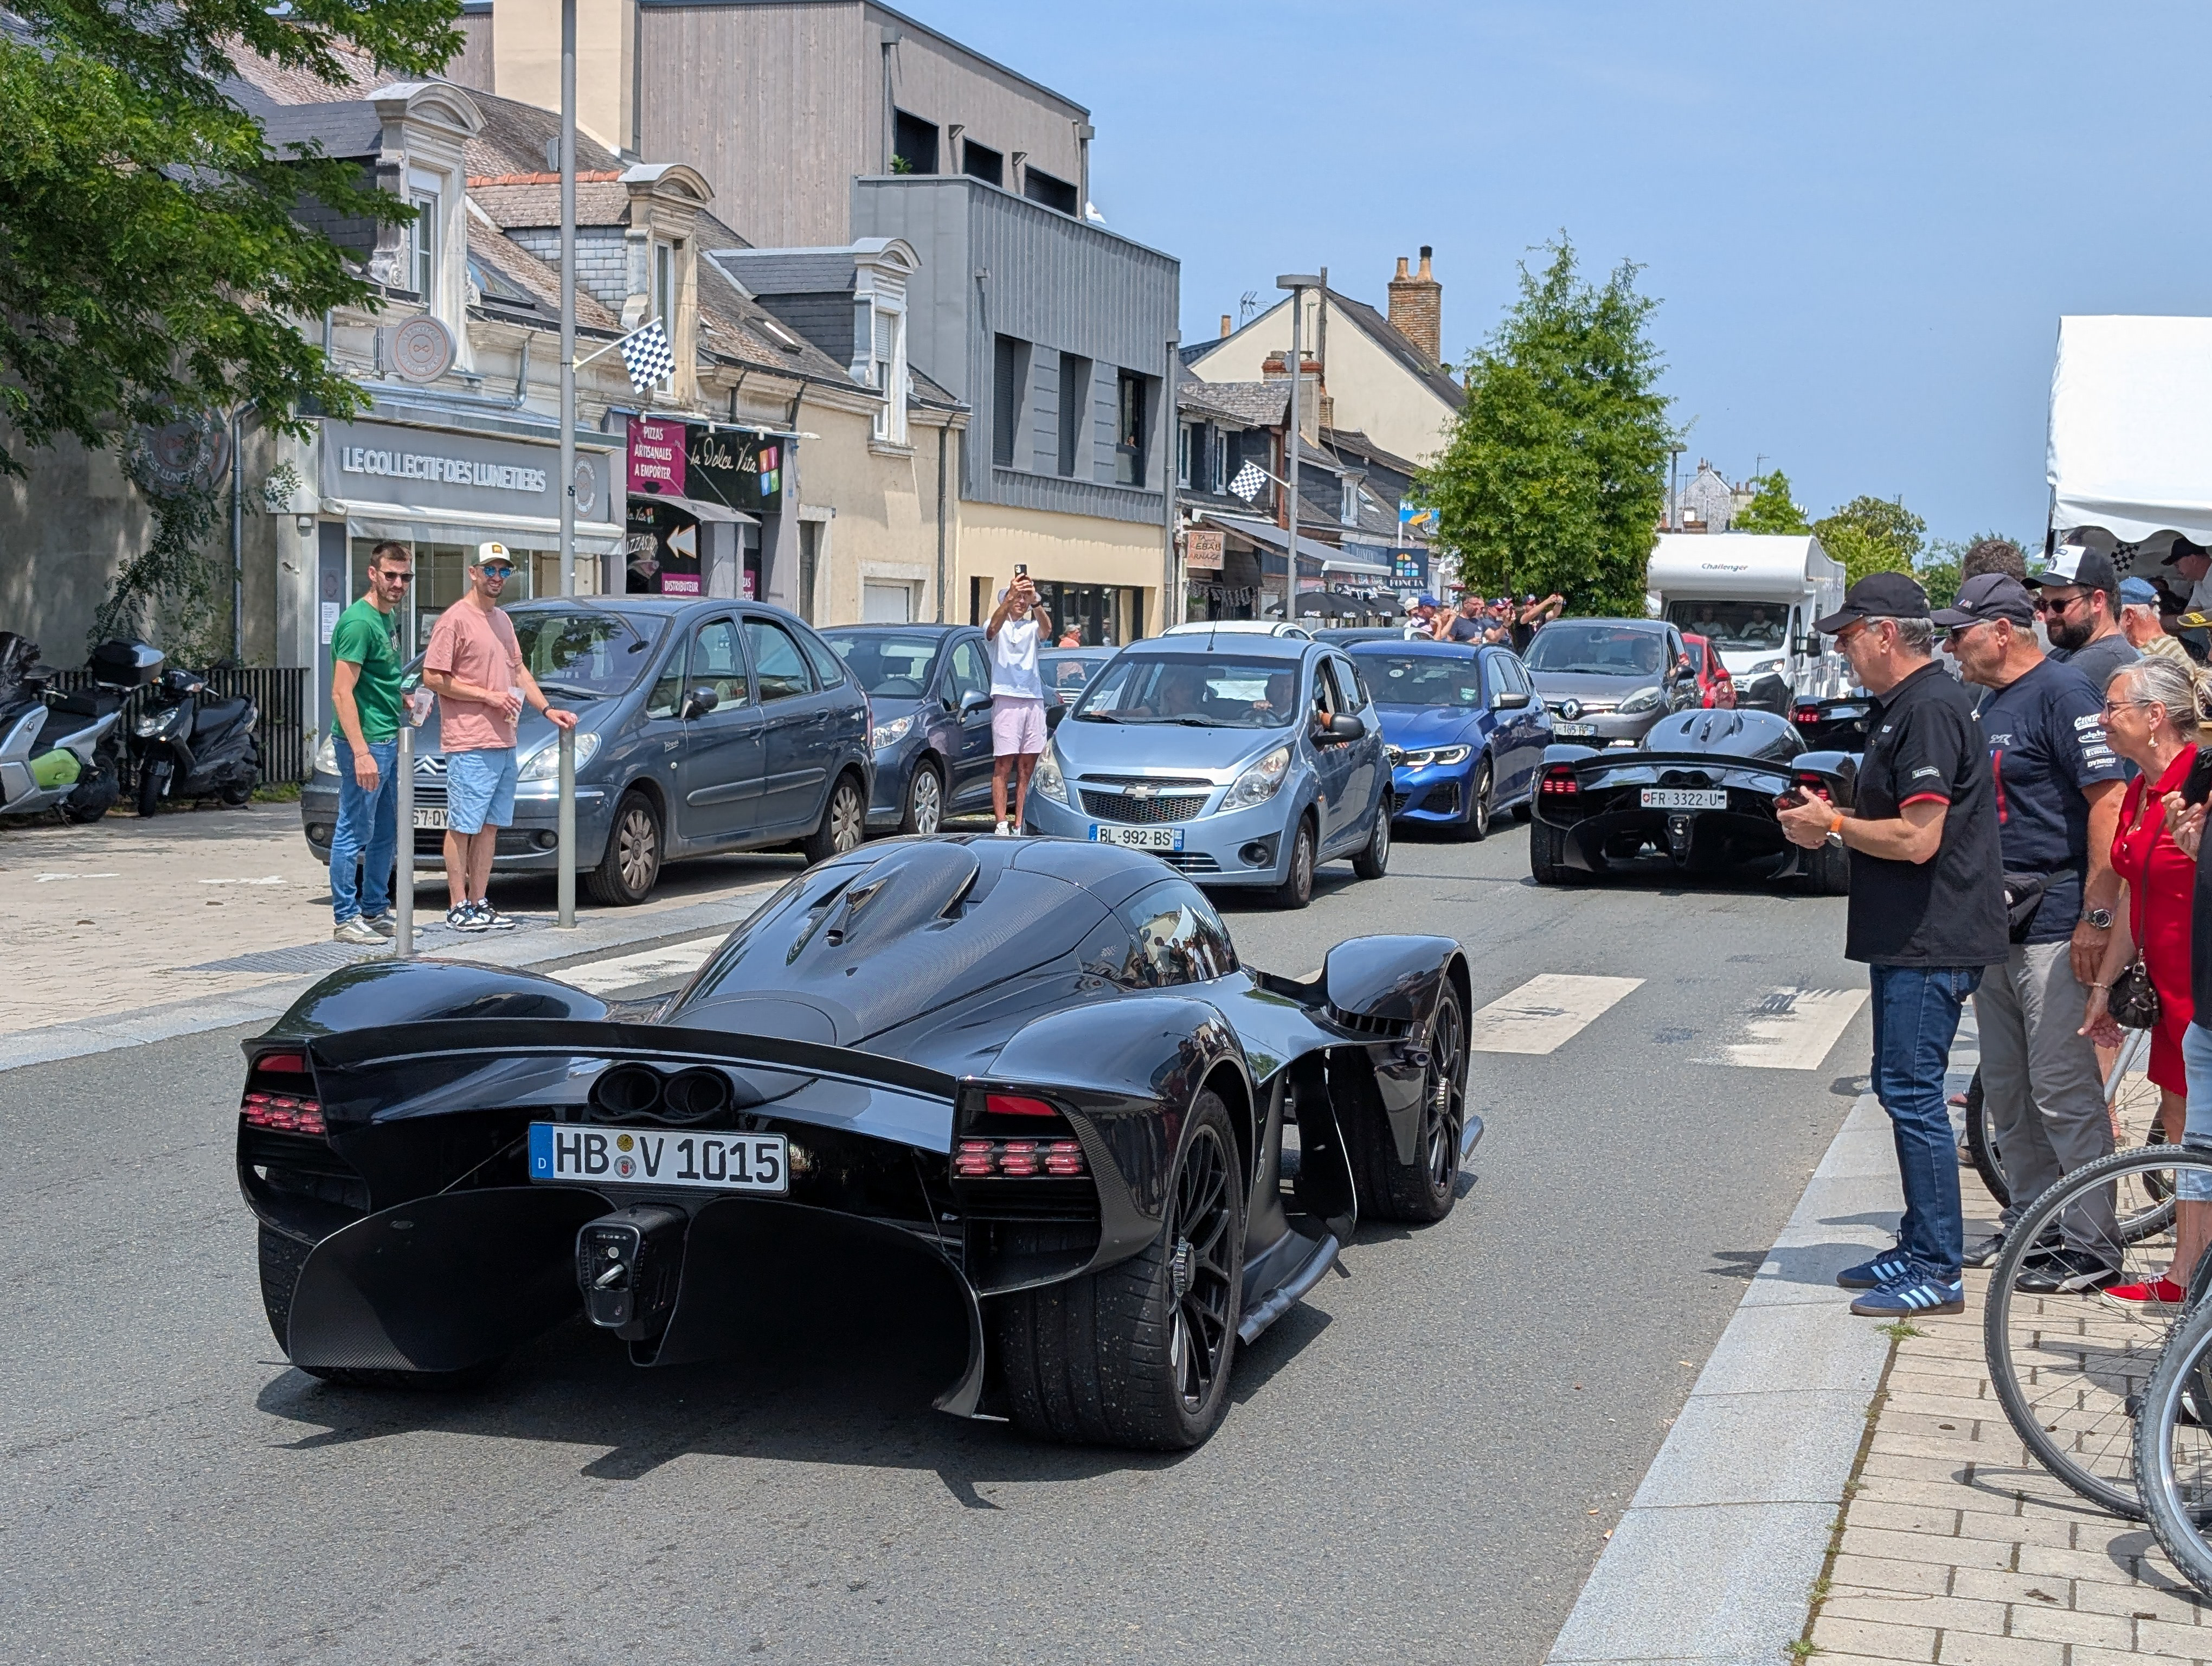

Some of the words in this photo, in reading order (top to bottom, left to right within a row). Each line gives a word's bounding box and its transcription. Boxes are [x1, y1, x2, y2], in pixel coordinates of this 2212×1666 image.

[643, 426, 664, 440] PIZZAS
[634, 444, 672, 462] ARTISANALES
[703, 436, 734, 470] Dolce
[735, 441, 757, 473] Vita
[343, 447, 364, 472] LE
[364, 450, 444, 481] COLLECTIF
[443, 459, 473, 485] DES
[473, 463, 546, 492] LUNETIERS
[634, 463, 640, 477] A
[641, 464, 671, 480] EMPORTER
[1701, 563, 1748, 572] Challenger
[665, 580, 699, 593] DISTRIBUTEUR
[1390, 579, 1424, 587] FONCIA
[538, 1157, 546, 1169] D
[556, 1132, 609, 1174] HB
[639, 1136, 664, 1177] V
[677, 1138, 780, 1183] 1015
